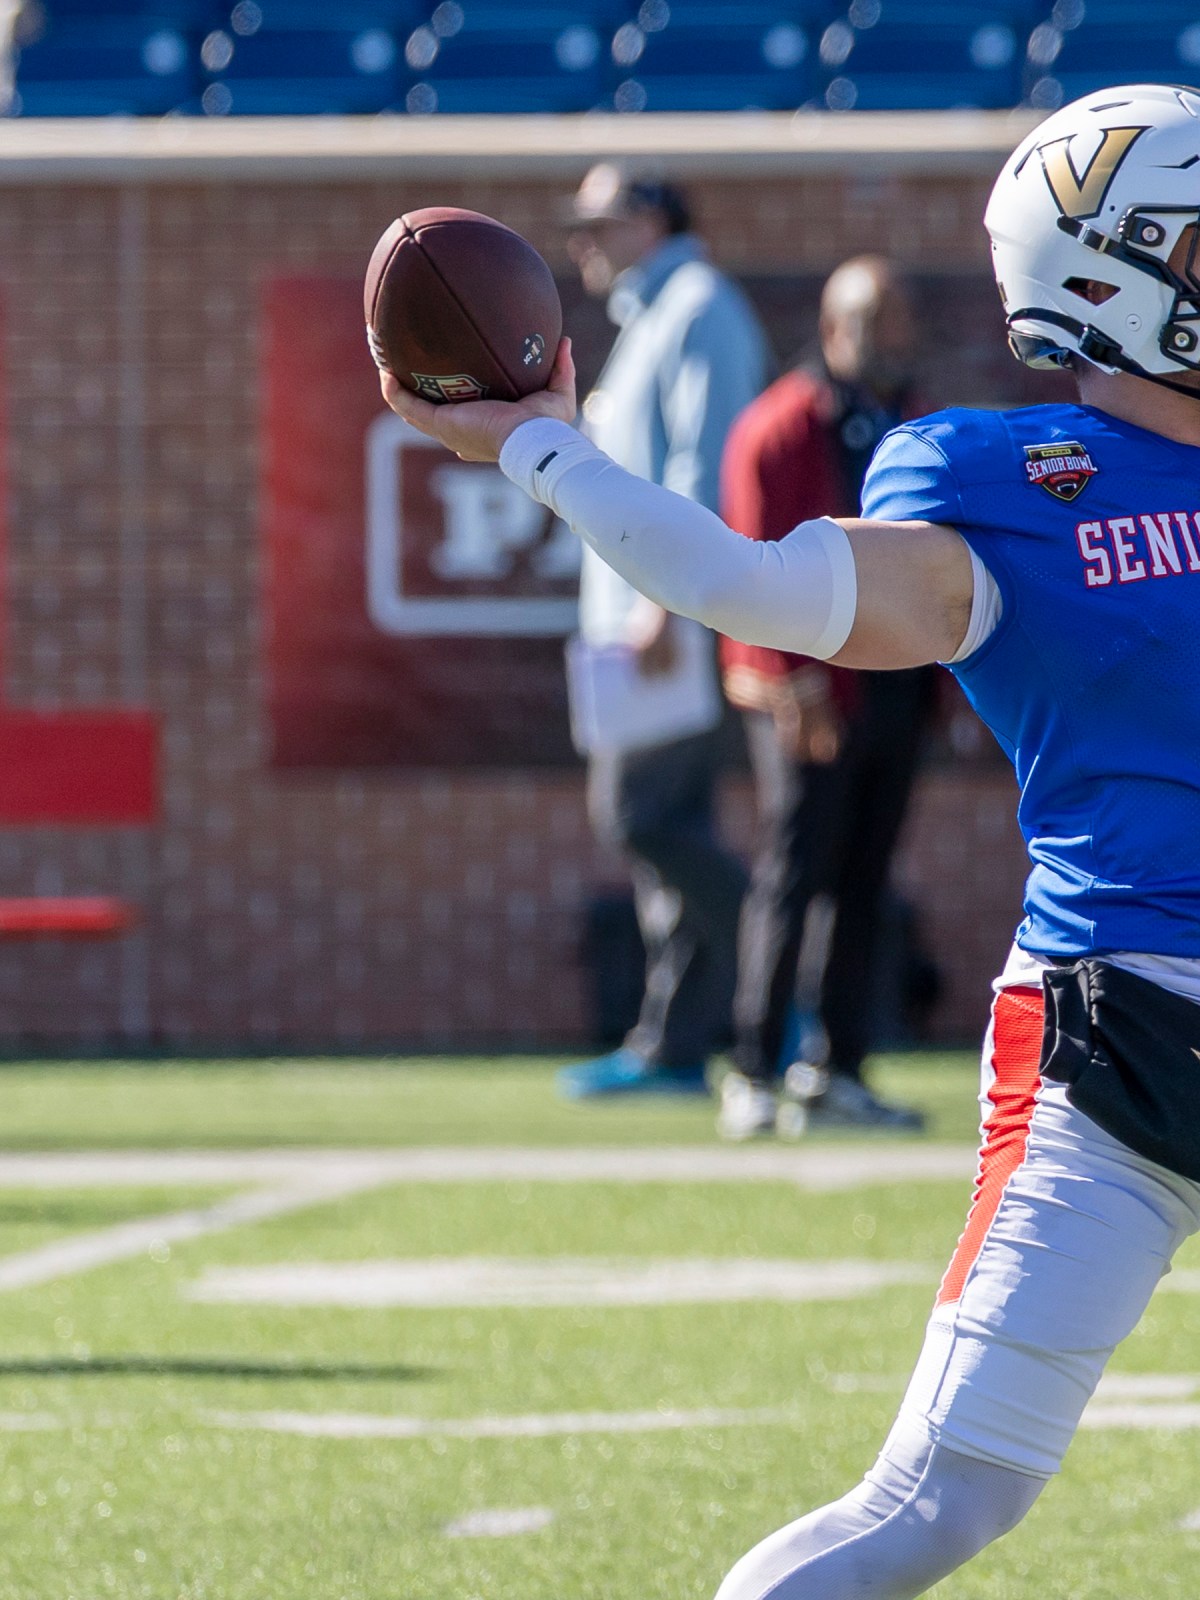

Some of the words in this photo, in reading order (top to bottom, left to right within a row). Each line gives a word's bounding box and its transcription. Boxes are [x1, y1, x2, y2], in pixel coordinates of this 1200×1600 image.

[1036, 125, 1153, 220] V
[1026, 457, 1066, 481] SENIOR
[1065, 454, 1098, 472] BOWL
